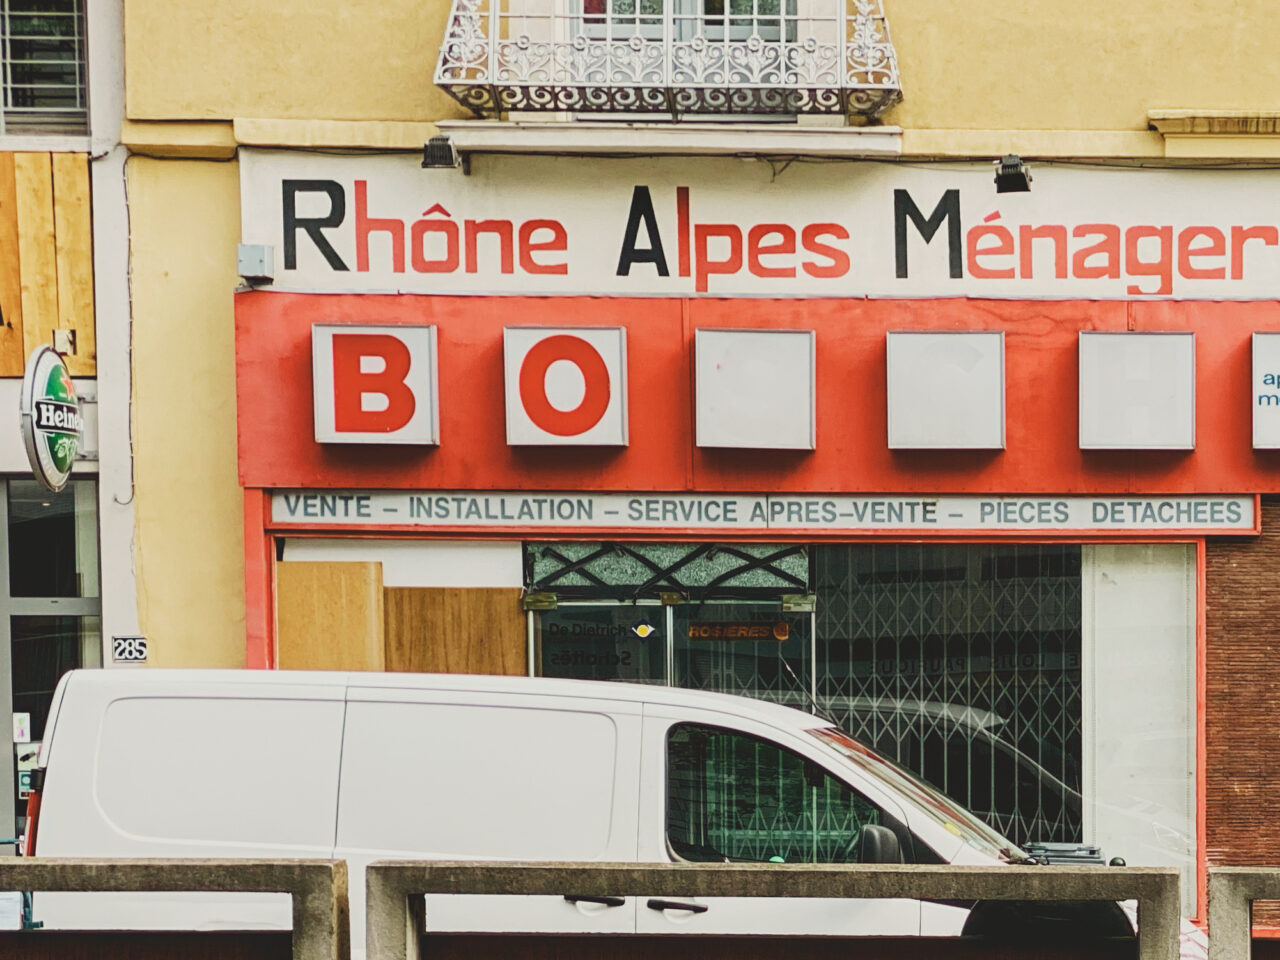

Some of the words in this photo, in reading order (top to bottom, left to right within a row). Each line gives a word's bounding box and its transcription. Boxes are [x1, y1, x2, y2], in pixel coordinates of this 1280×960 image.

[282, 179, 568, 275] Rhône
[616, 185, 850, 292] Alpes
[894, 188, 1280, 296] Ménager
[284, 495, 371, 519] VENTE
[409, 496, 593, 521] INSTALLATION
[627, 499, 738, 522] SERVICE
[980, 501, 1070, 523] PIECES
[1092, 501, 1243, 523] DETACHEES
[549, 623, 569, 636] De
[572, 623, 627, 636] Dietrich
[114, 638, 147, 660] 285
